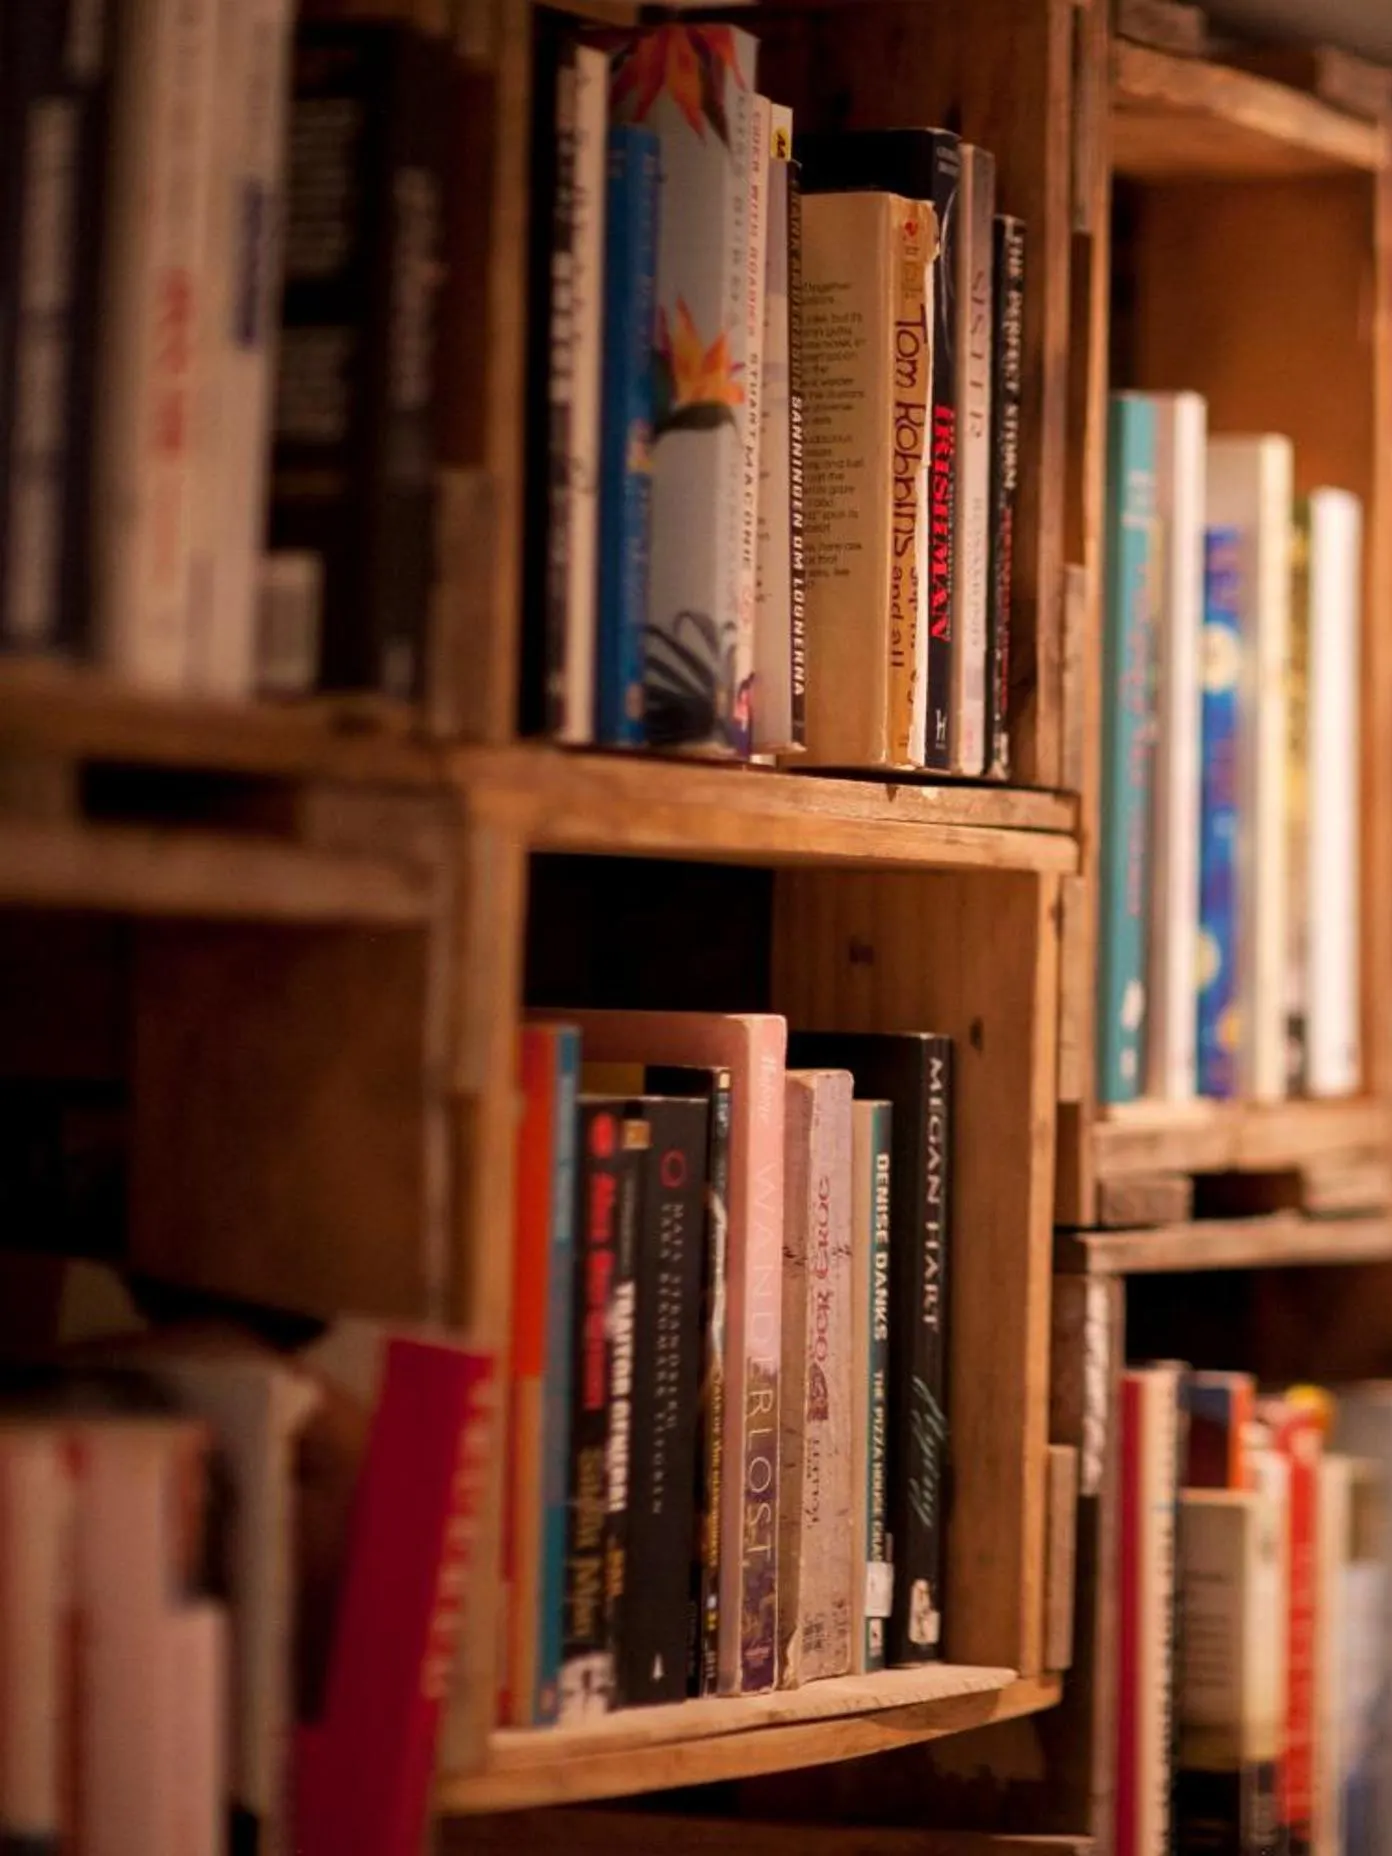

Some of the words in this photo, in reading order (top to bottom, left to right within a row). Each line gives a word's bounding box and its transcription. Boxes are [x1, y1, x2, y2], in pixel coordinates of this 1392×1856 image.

[1007, 233, 1024, 277] THE
[894, 303, 928, 390] Tom
[969, 269, 986, 440] SISTER
[1006, 291, 1022, 392] PERFECT
[748, 354, 759, 439] STUART
[931, 404, 957, 644] IRISHMAN
[891, 565, 905, 621] and
[891, 628, 905, 668] all
[927, 1057, 943, 1204] MEGAN
[875, 1153, 890, 1243] DENISE
[873, 1252, 889, 1341] DANKS
[922, 1220, 941, 1334] HART
[610, 1281, 637, 1396] TRAITOR
[873, 1369, 885, 1402] THE
[605, 1400, 632, 1512] GENERAL
[872, 1406, 885, 1457] PIZZA
